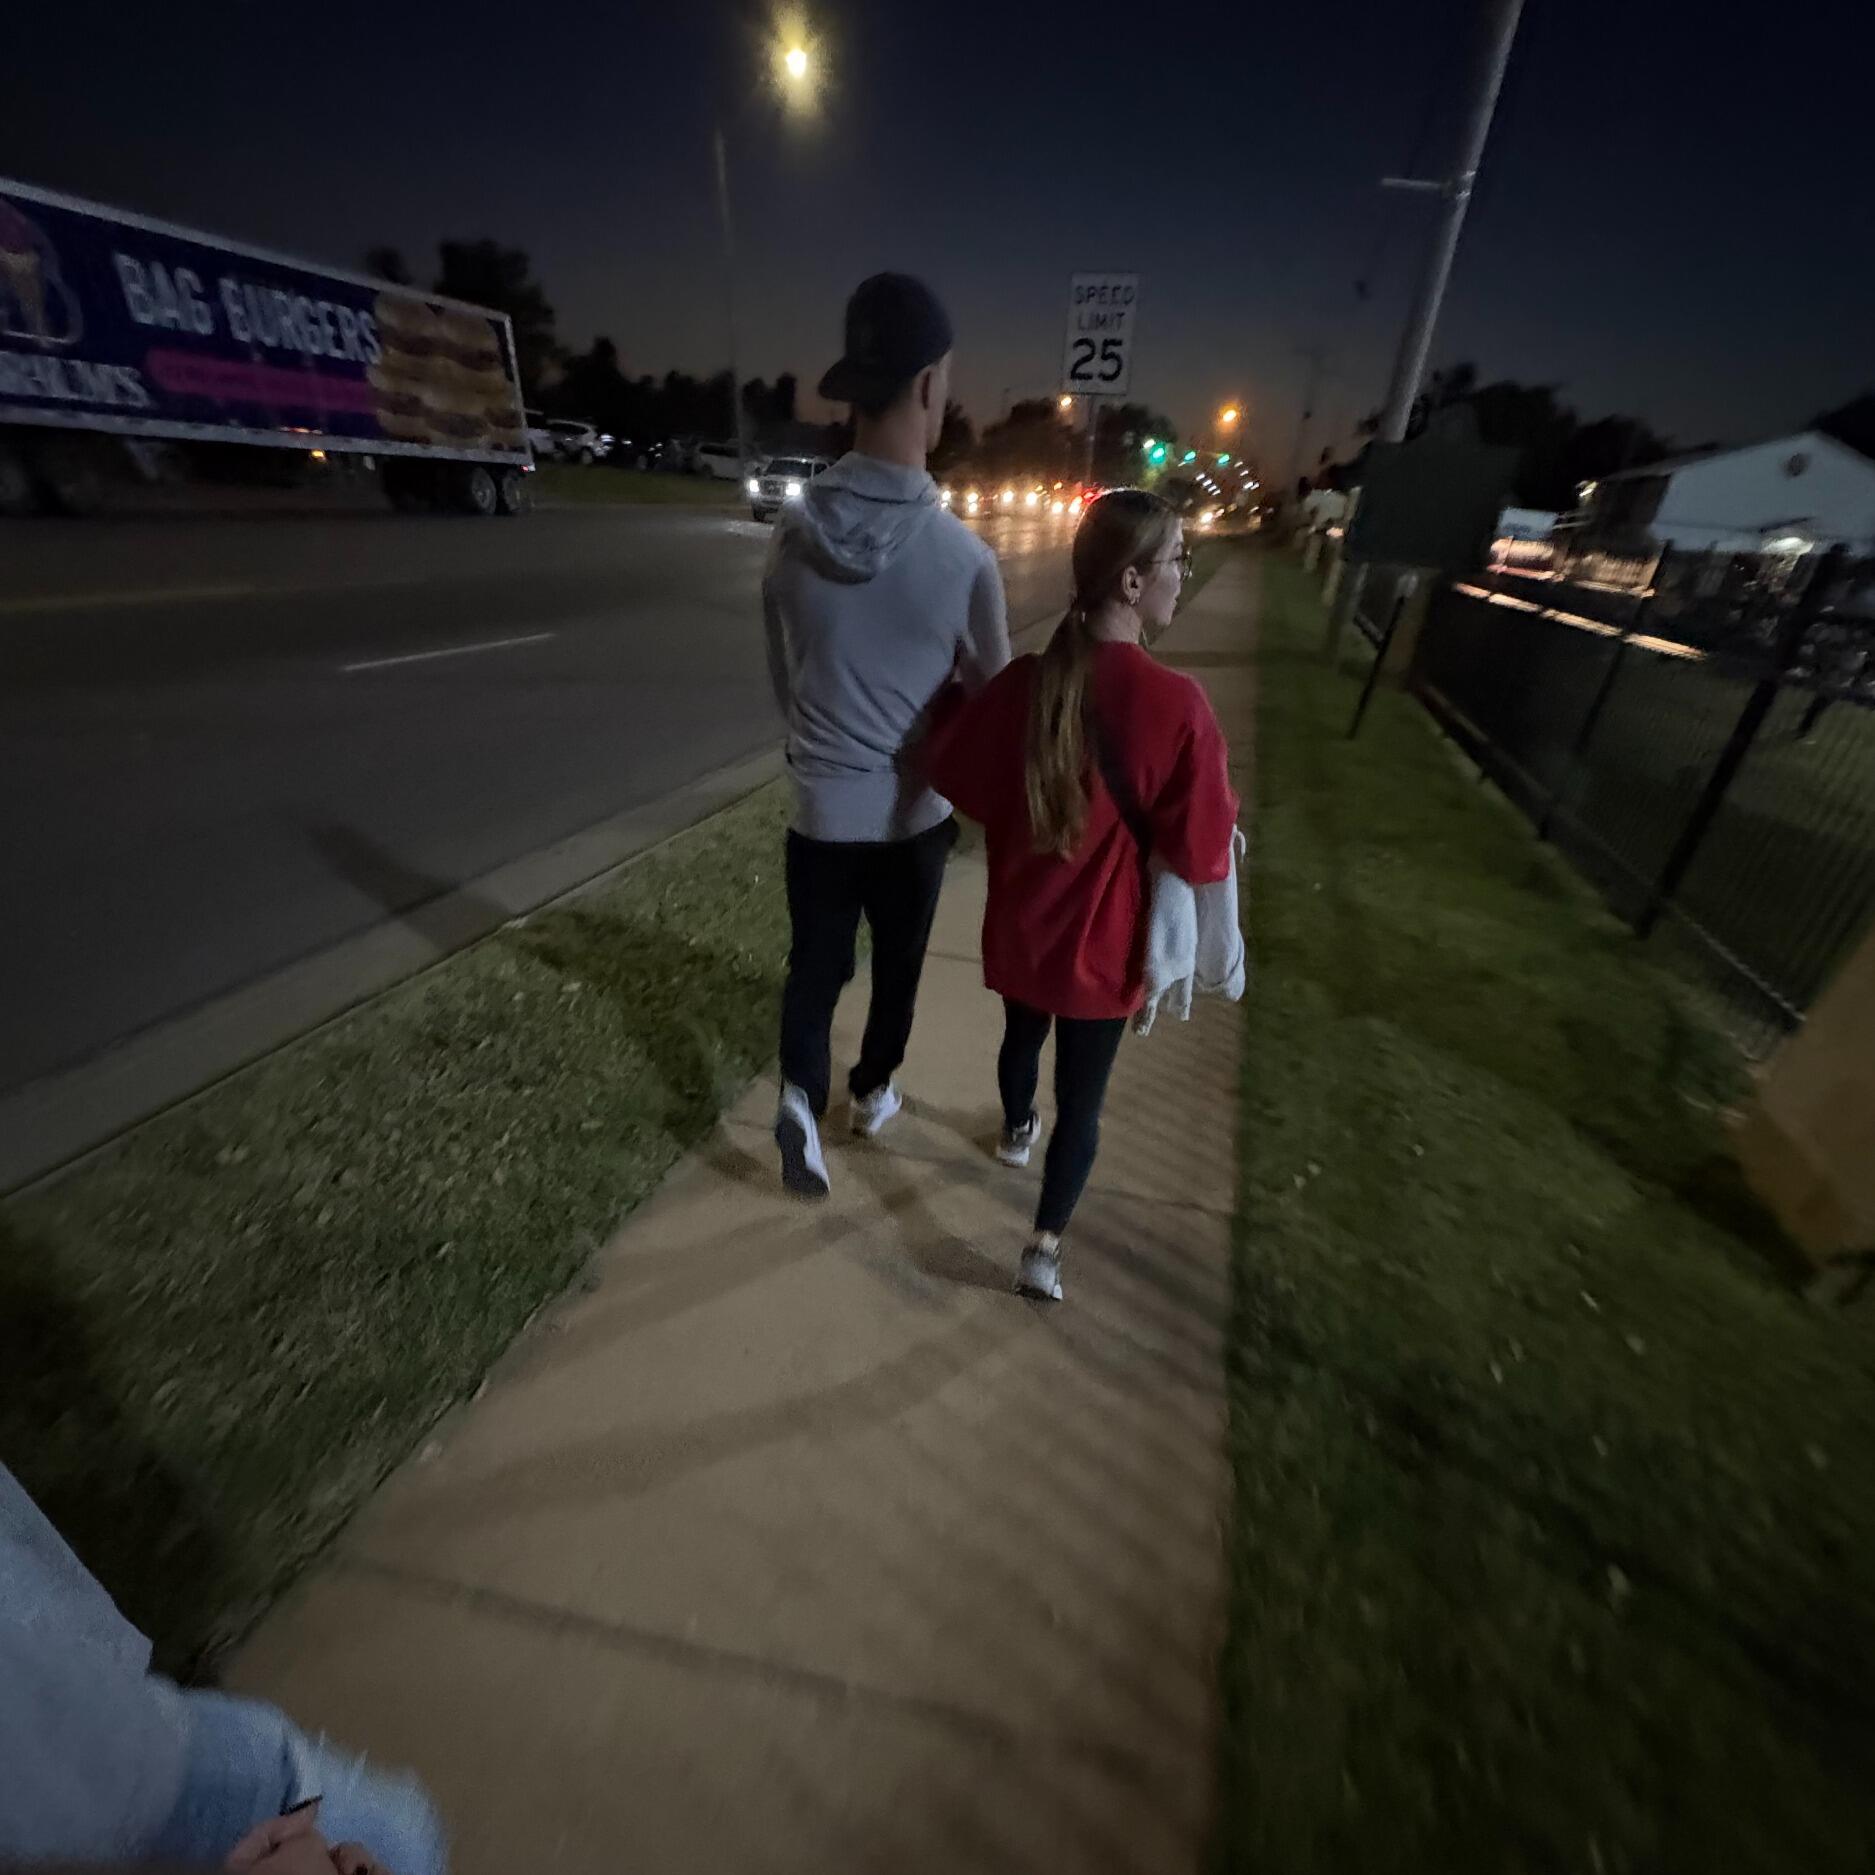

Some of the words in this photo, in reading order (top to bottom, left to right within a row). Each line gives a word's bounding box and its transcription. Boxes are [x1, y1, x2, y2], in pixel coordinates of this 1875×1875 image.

[112, 248, 215, 336] BAG
[220, 276, 384, 366] BURGERS
[1075, 284, 1135, 305] SPEED
[1077, 311, 1126, 331] LIMIT
[1070, 338, 1123, 381] 25
